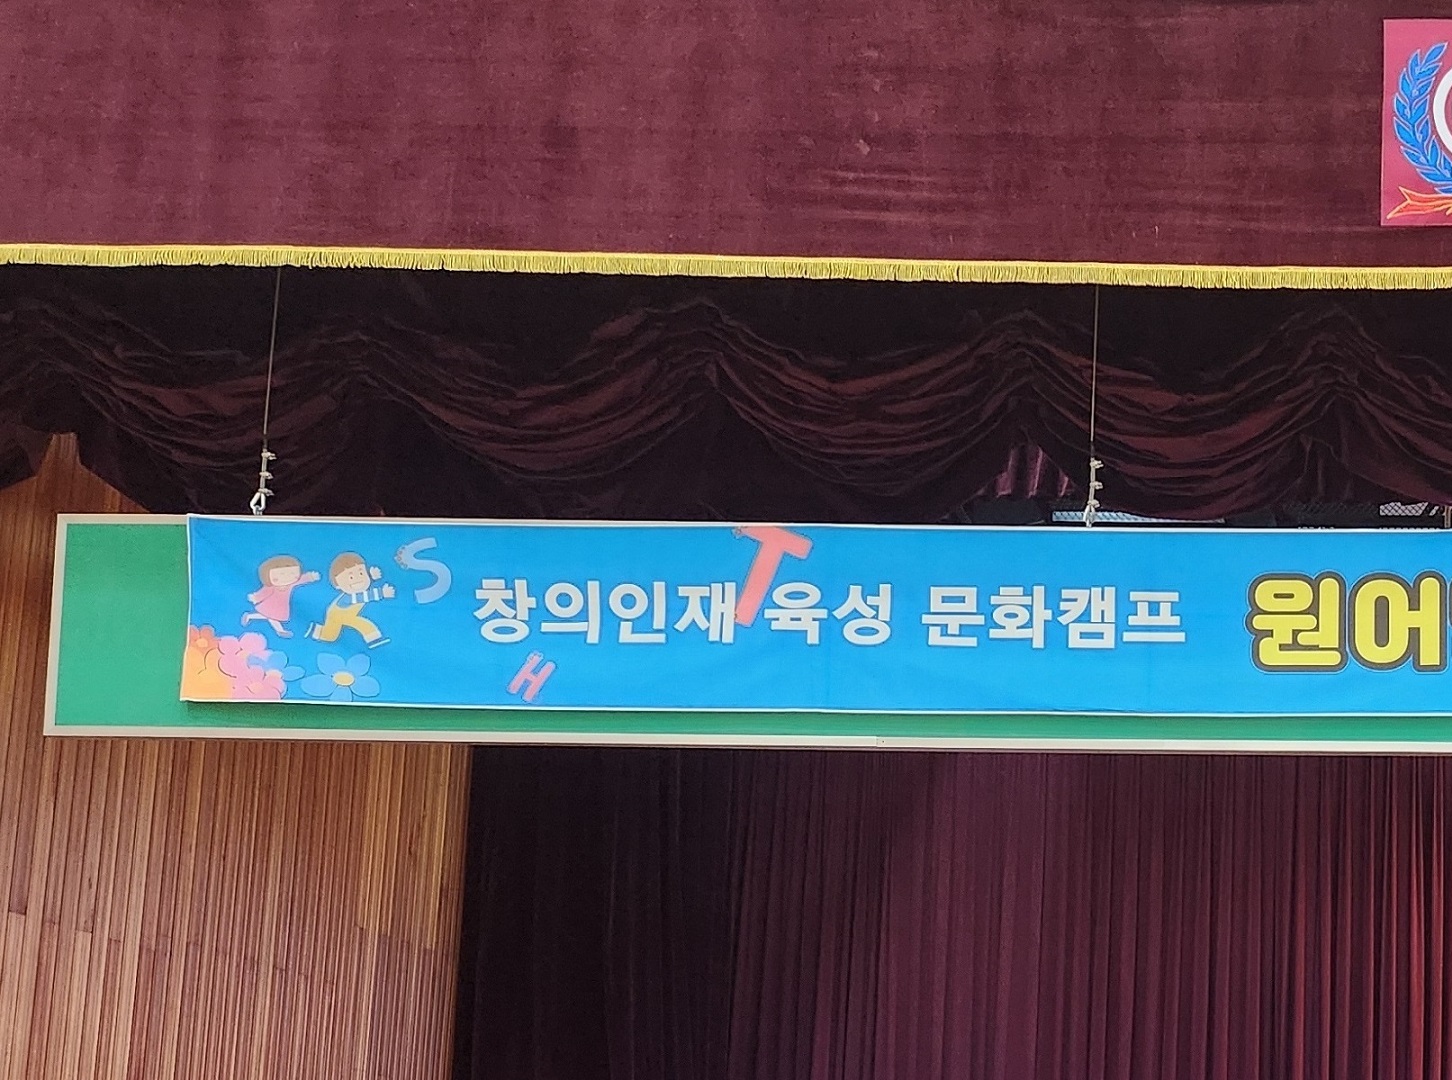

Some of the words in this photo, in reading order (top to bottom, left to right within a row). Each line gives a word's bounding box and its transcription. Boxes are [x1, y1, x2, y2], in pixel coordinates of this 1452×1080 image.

[473, 578, 737, 644] 창의인재
[764, 581, 893, 646] 육성
[921, 583, 1187, 650] 문화캠프
